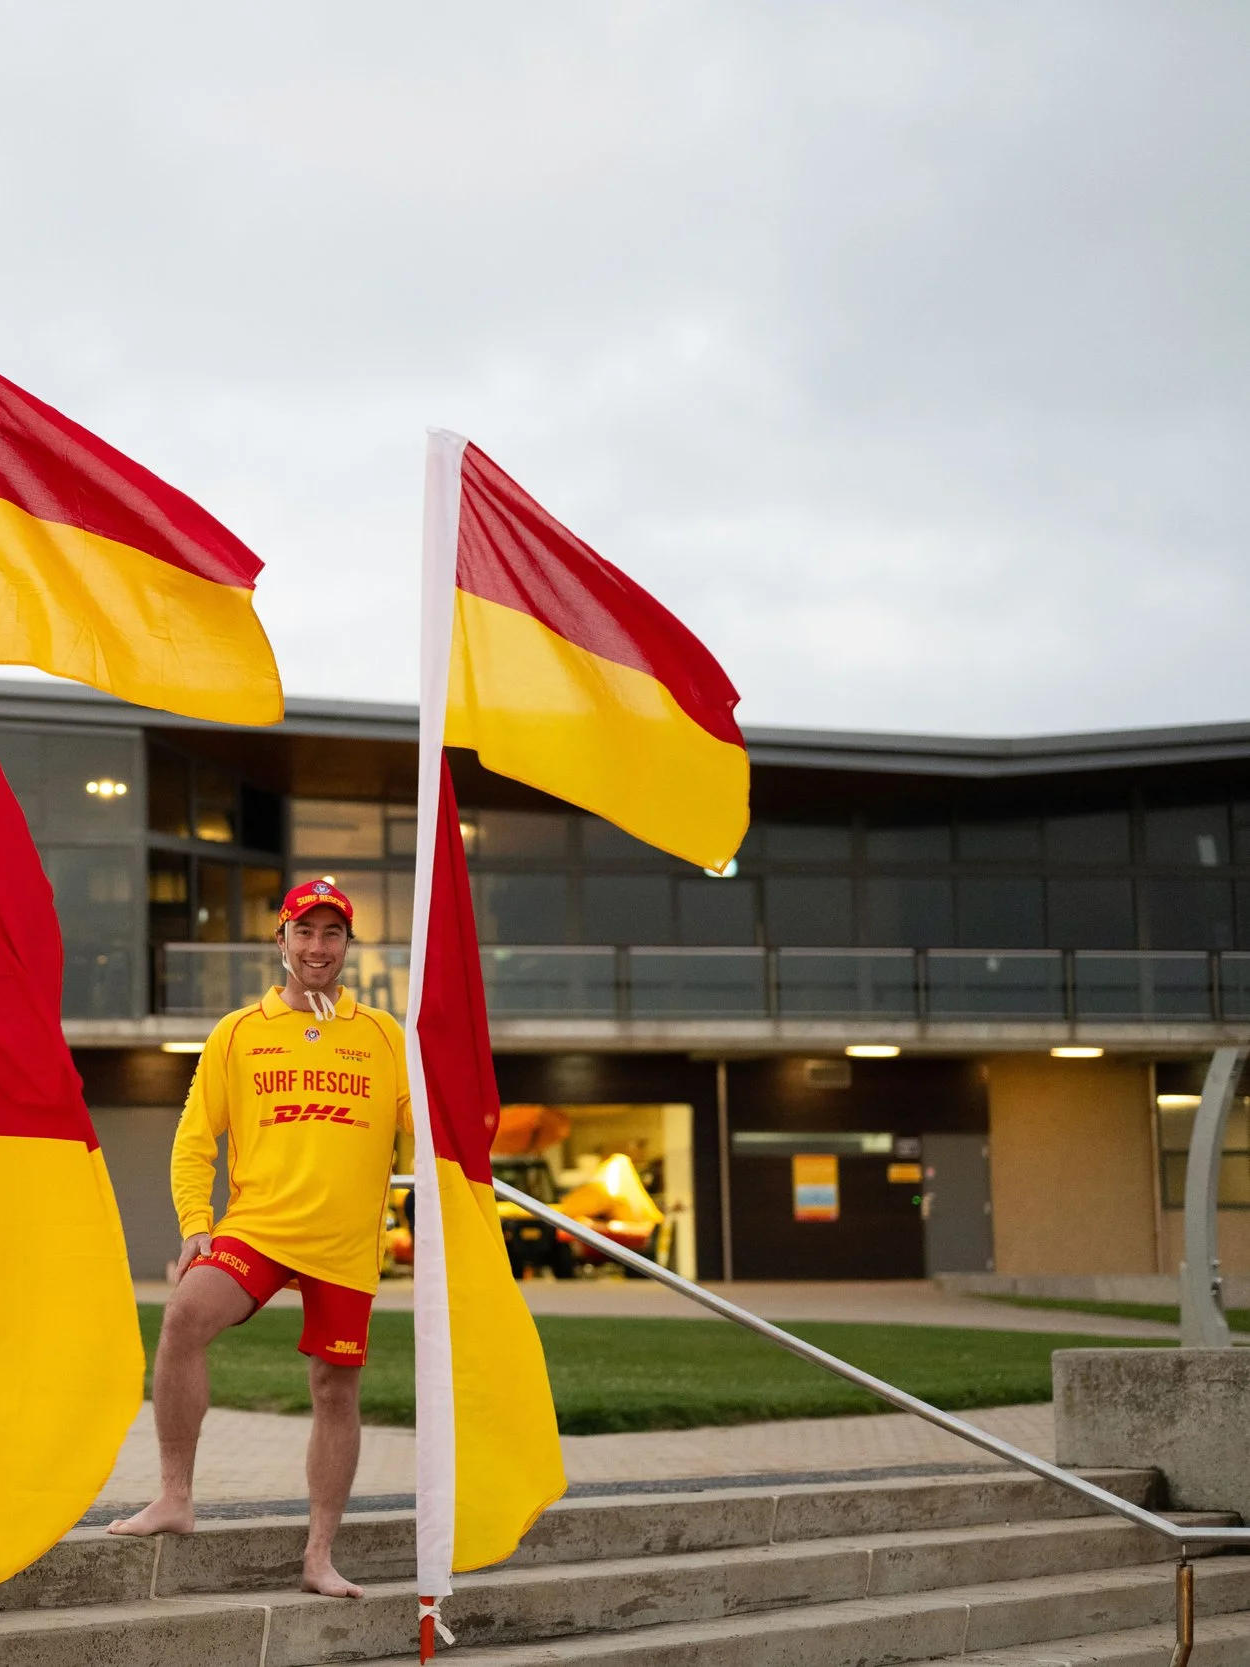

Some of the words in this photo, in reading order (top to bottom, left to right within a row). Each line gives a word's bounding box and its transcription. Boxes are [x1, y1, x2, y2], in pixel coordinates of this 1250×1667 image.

[296, 894, 318, 907] SURF
[319, 894, 346, 911] RESCUE
[251, 1047, 285, 1056] DHL
[335, 1048, 371, 1059] ISUZU
[253, 1069, 298, 1096] SURF
[303, 1069, 370, 1099] RESCUE
[273, 1103, 356, 1125] DHL
[218, 1251, 250, 1277] RESCUE
[334, 1340, 358, 1354] DHL
